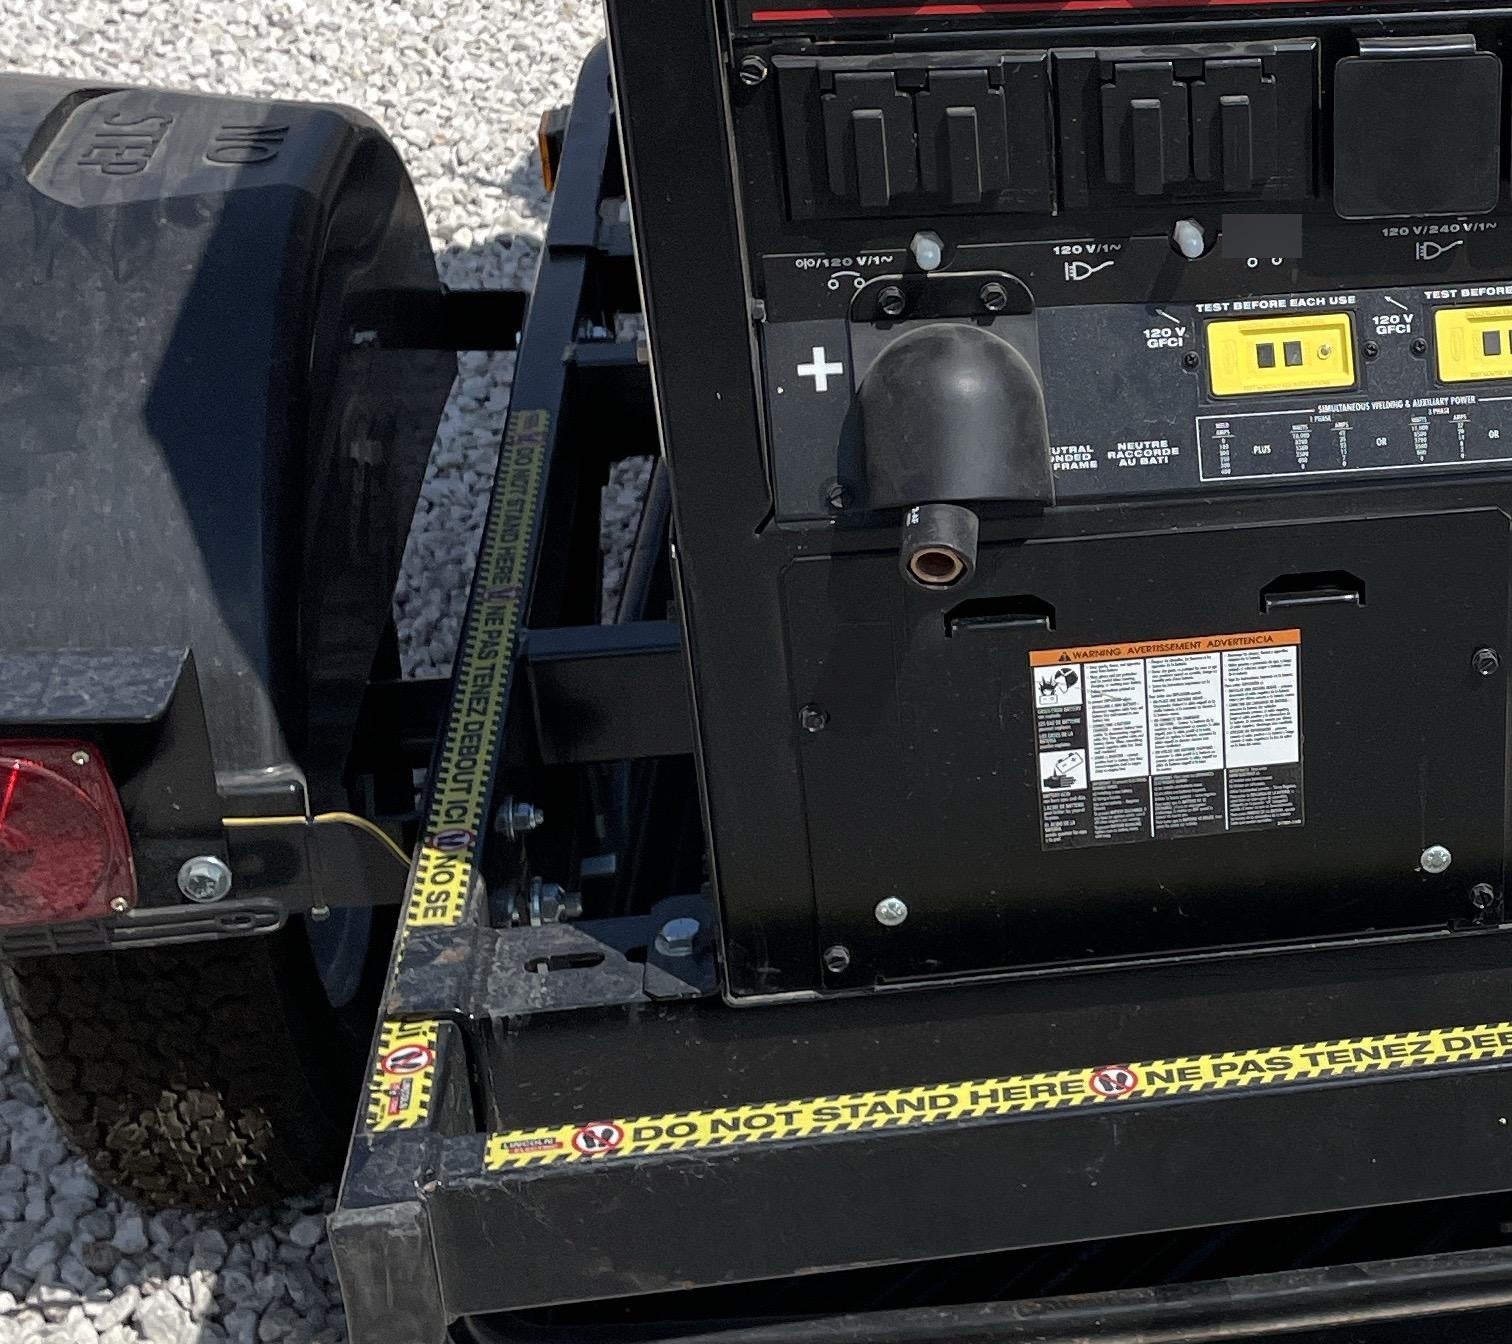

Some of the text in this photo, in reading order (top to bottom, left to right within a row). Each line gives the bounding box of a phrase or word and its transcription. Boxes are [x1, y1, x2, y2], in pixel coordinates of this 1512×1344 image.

[1381, 225, 1457, 237] 120 V/240
[1053, 245, 1084, 255] 120
[1425, 289, 1458, 300] TEST
[1461, 286, 1512, 297] BEFORE
[1196, 295, 1356, 313] TEST BEFORE EACH USE
[1372, 313, 1413, 325] 120 V
[1143, 327, 1186, 339] 120 V
[1376, 323, 1411, 335] GFCI
[1147, 337, 1183, 348] GFCI
[1317, 403, 1370, 413] SIMULTANEOUS
[1413, 397, 1449, 407] AUXILIARY
[1451, 396, 1476, 405] POWER
[1488, 430, 1499, 439] OR
[1117, 440, 1169, 450] NEUTRE
[1376, 437, 1387, 447] OR
[1107, 447, 1180, 459] RACCORDE
[1253, 445, 1272, 455] PLUS
[1053, 460, 1098, 471] FRAME
[1119, 456, 1169, 467] AU BATI
[478, 629, 502, 661] PAS
[1072, 635, 1274, 660] WARNING AVERTISSEMENT ADVERTENCIA
[466, 665, 496, 718] TENEZ
[449, 720, 485, 796] DEBOUT
[443, 798, 470, 825] ICI
[422, 853, 458, 919] NO SE
[1145, 1065, 1203, 1086] NE
[1212, 1055, 1293, 1077] PAS
[1302, 1040, 1435, 1067] TENEZ
[633, 1078, 1085, 1142] DO NOT STAND HERE
